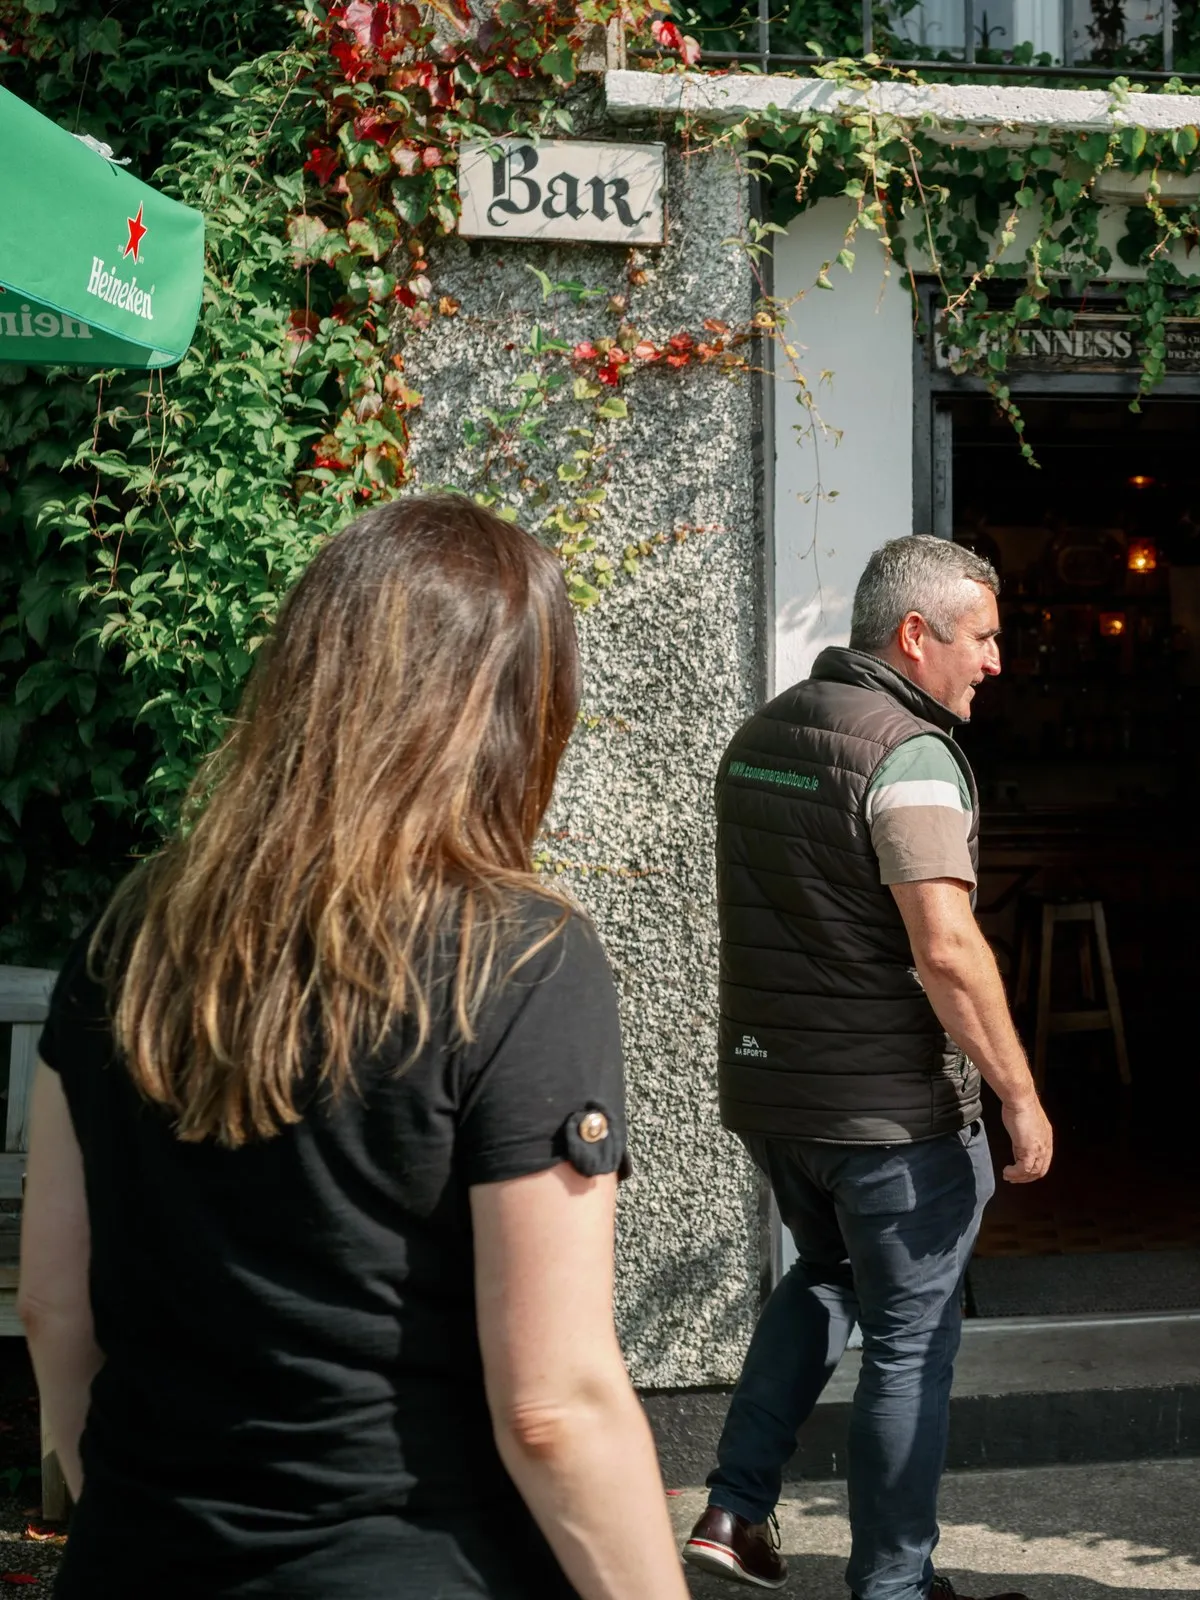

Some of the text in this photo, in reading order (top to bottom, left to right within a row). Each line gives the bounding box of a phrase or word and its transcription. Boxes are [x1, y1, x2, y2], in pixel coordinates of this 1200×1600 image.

[87, 256, 154, 320] Heineken
[742, 1035, 759, 1048] SA
[743, 1048, 768, 1058] SPORTS
